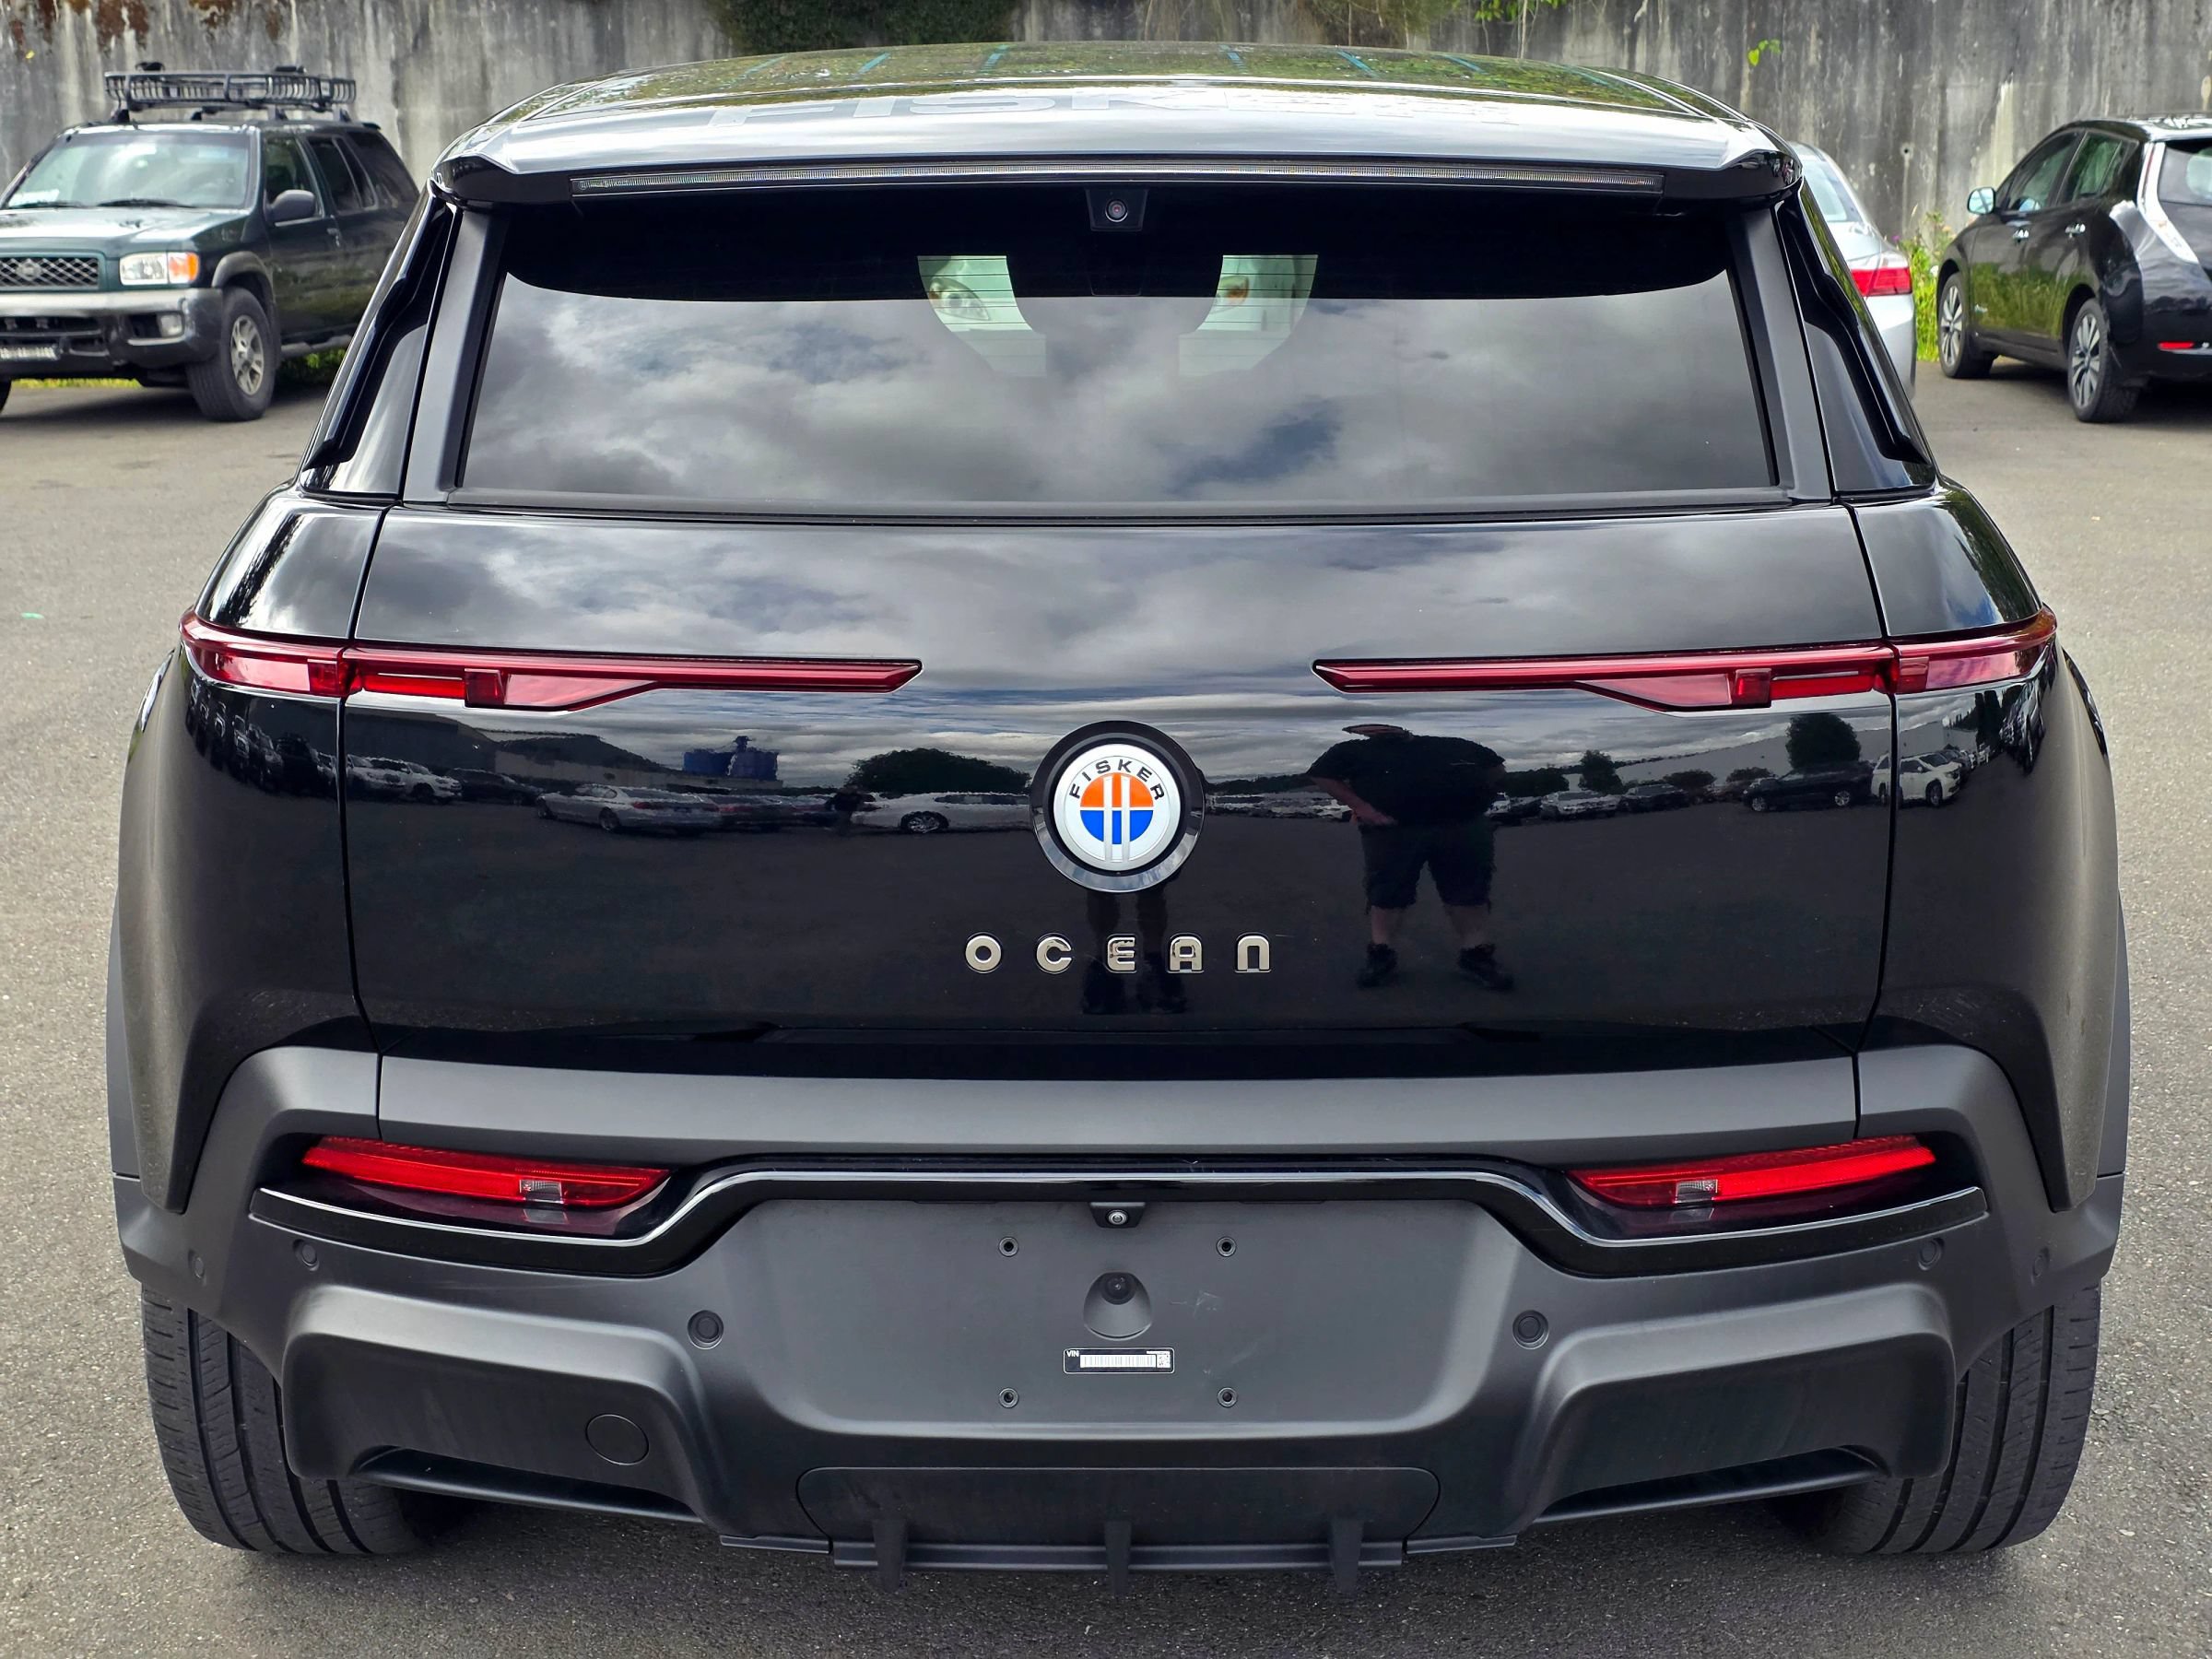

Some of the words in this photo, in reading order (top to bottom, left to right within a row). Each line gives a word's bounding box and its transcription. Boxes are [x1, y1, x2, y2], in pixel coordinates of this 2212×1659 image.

[1069, 759, 1164, 800] FISKER
[965, 935, 1270, 972] OCEAN
[1066, 1349, 1079, 1358] VIN
